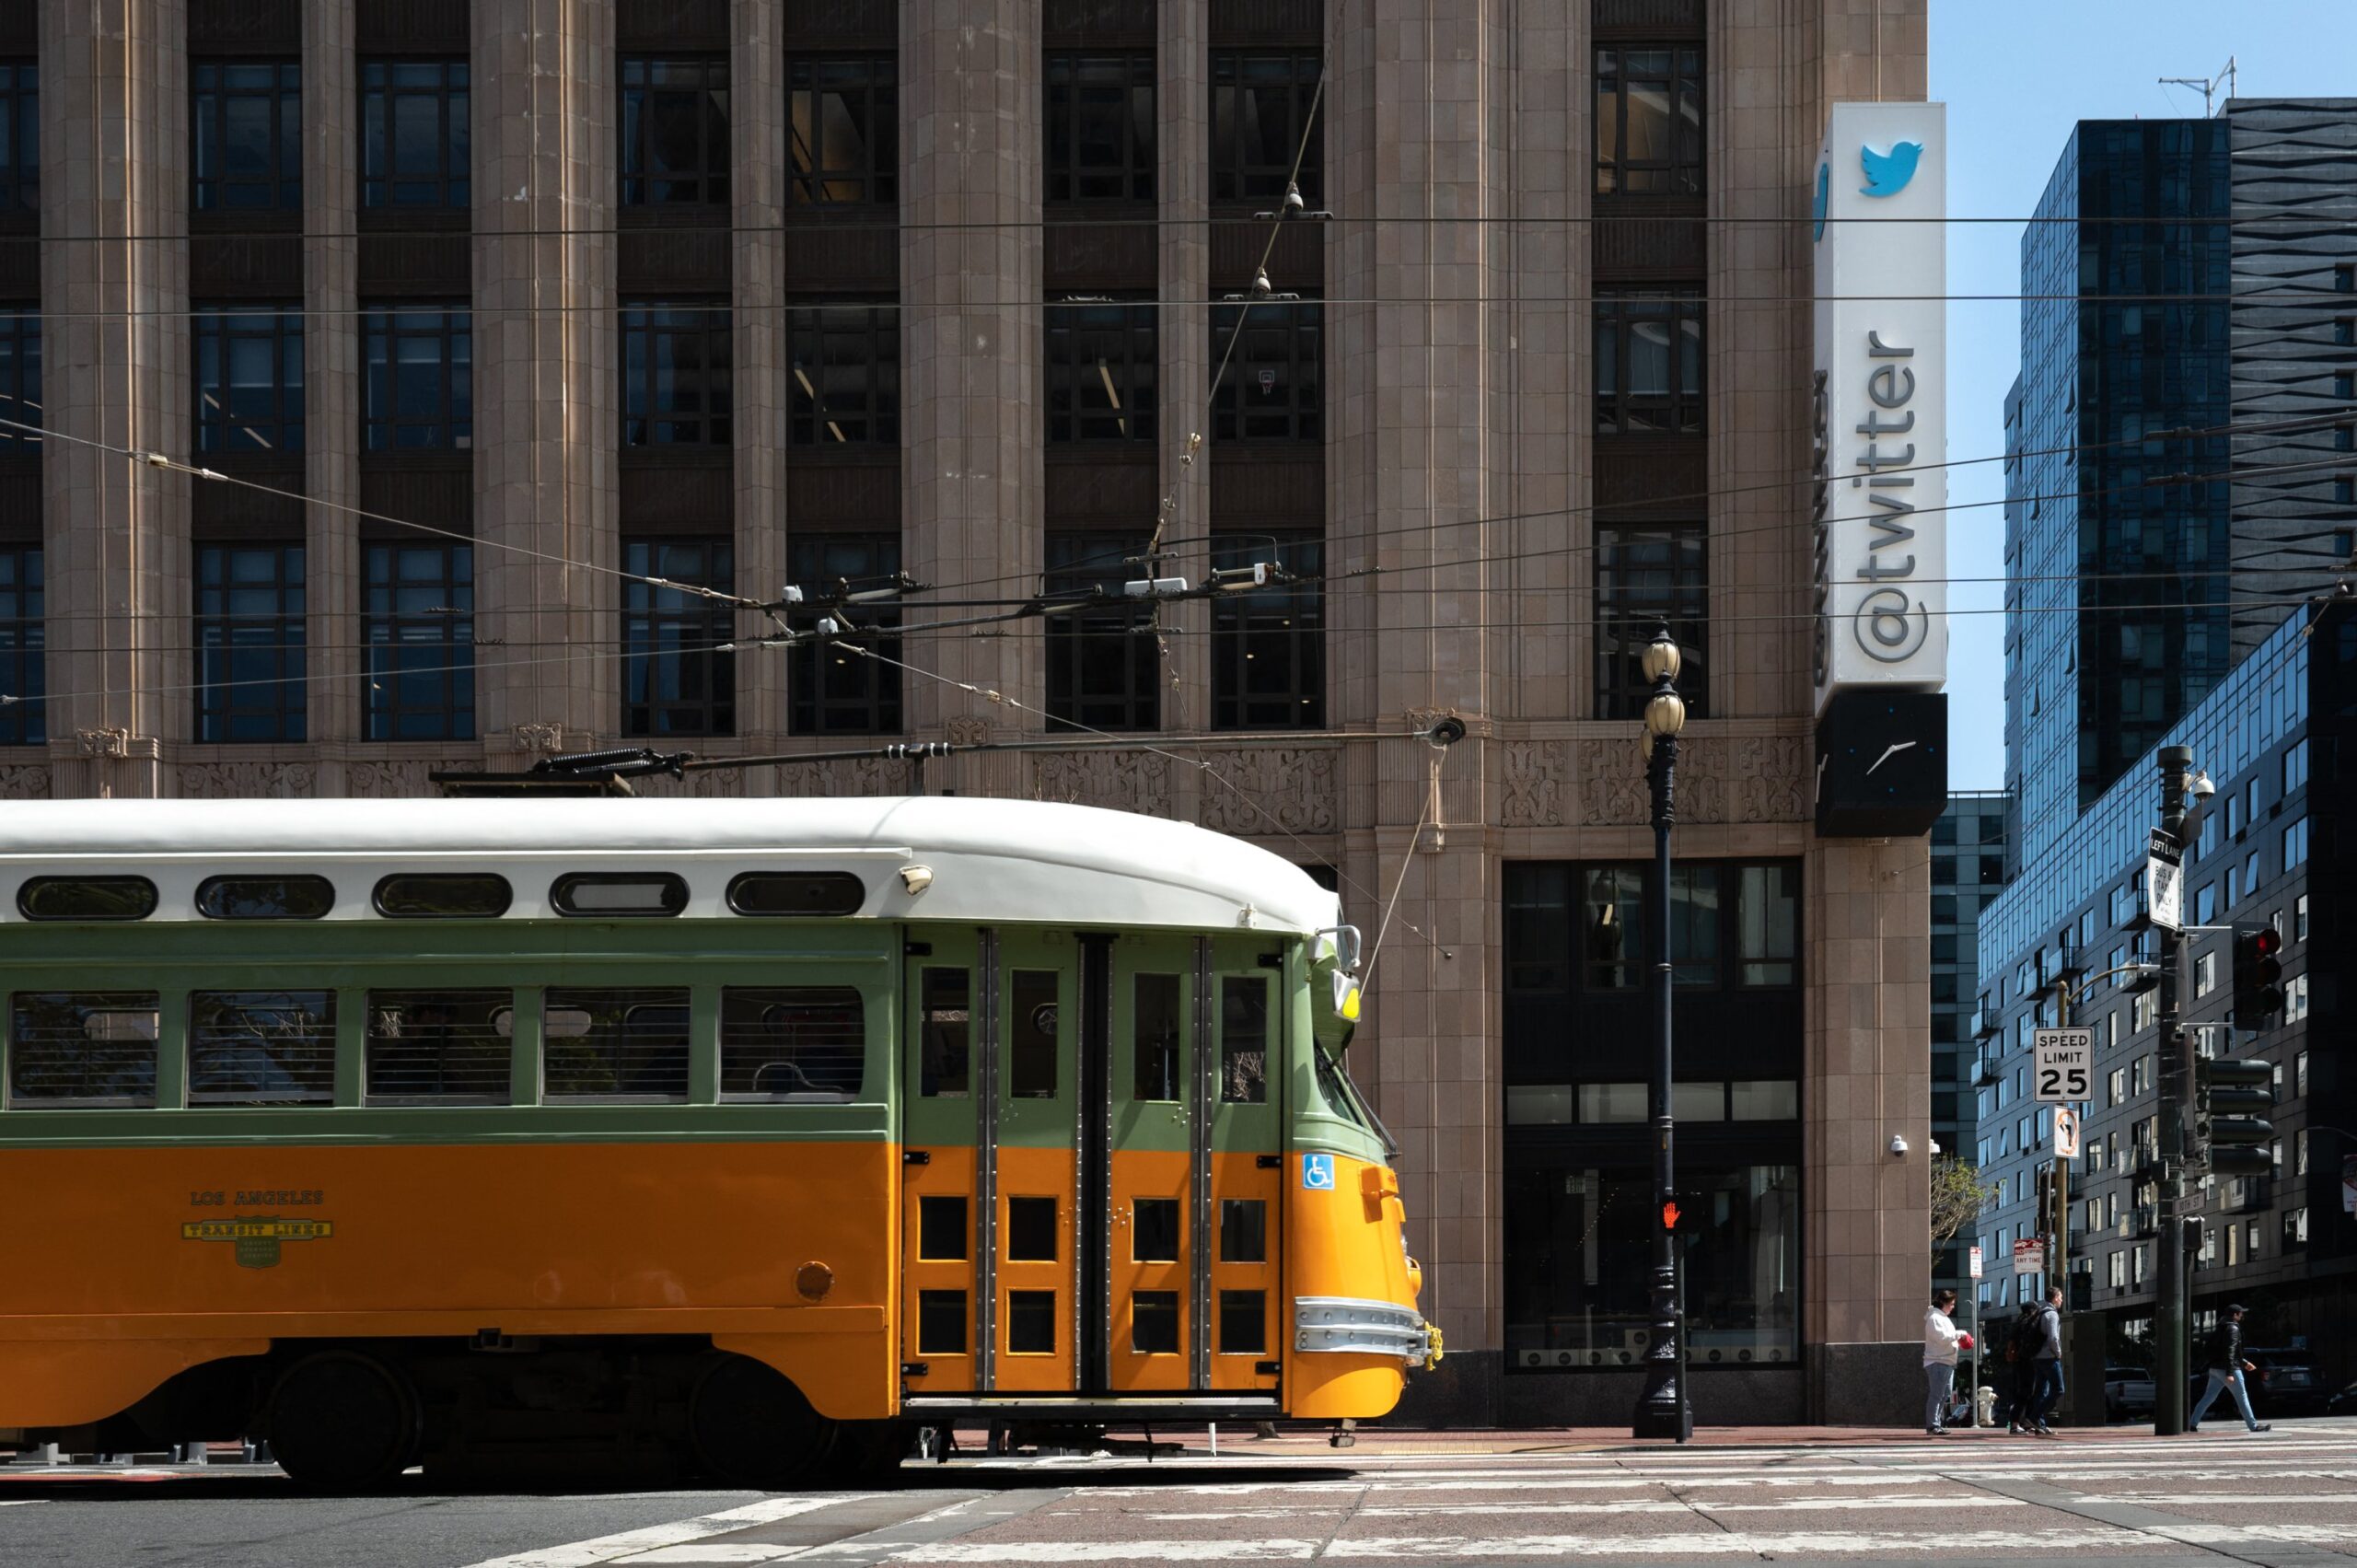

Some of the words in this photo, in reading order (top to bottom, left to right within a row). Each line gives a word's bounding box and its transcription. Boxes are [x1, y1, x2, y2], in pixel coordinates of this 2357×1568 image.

[1853, 331, 1929, 663] @twitter
[2151, 838, 2165, 854] LEFT
[2165, 843, 2180, 859] LANE
[2155, 865, 2166, 879] BUS
[2167, 872, 2172, 881] &
[2157, 894, 2172, 907] ONLY
[2039, 1035, 2088, 1047] SPEED
[2044, 1051, 2083, 1063] LIMIT
[2040, 1069, 2087, 1095] 25
[191, 1191, 226, 1206] LOS
[235, 1191, 324, 1205] ANGELES
[2193, 1196, 2200, 1208] ST
[190, 1225, 264, 1236] TRANSIT
[273, 1225, 325, 1236] LINES
